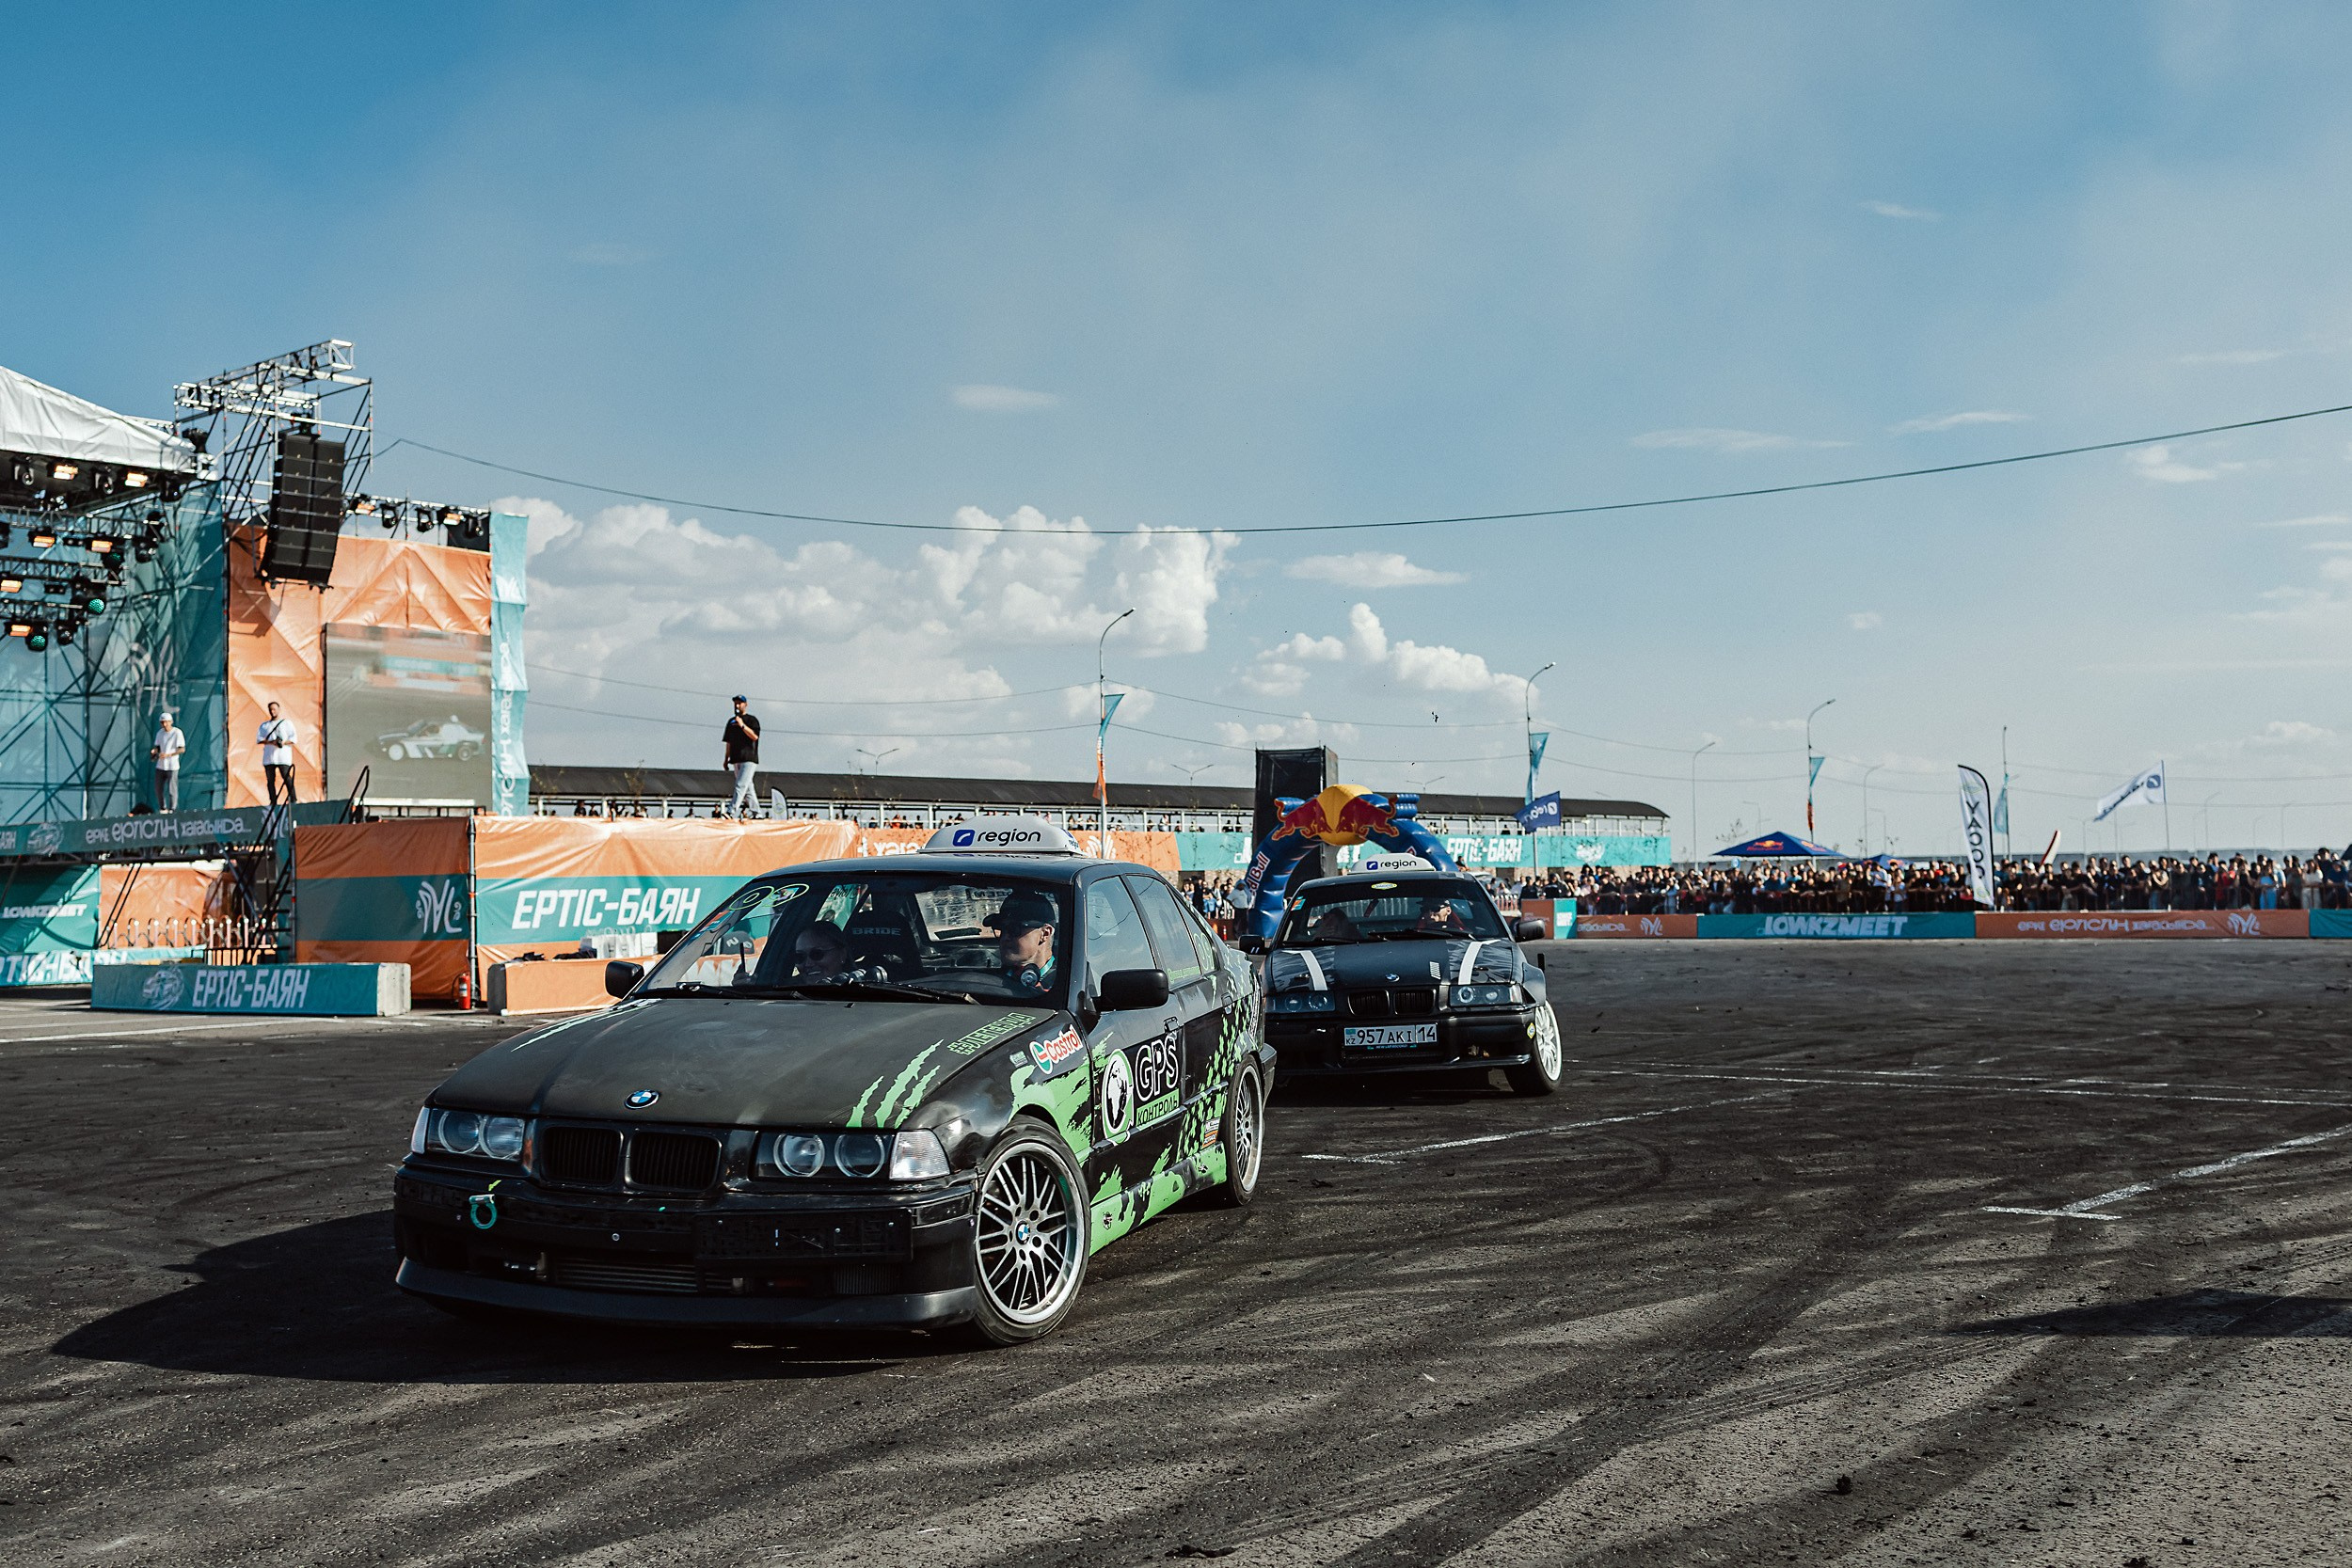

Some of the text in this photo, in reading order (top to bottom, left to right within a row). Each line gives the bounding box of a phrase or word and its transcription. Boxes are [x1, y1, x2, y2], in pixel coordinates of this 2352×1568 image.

[977, 828, 1041, 847] region
[1249, 850, 1271, 881] Bull
[1380, 860, 1417, 869] region
[512, 888, 701, 929] ЕРТІС-БАЯН
[852, 927, 901, 936] BRIDE
[1764, 916, 1908, 936] LOWKZMEET
[192, 969, 310, 1008] ЕРТІС-БАЯН
[1046, 1027, 1082, 1064] Castrol
[1357, 1028, 1385, 1045] 957
[1417, 1026, 1436, 1042] 14
[1136, 1031, 1179, 1101] GPS
[1137, 1100, 1178, 1126] КОНТРОЛЬ
